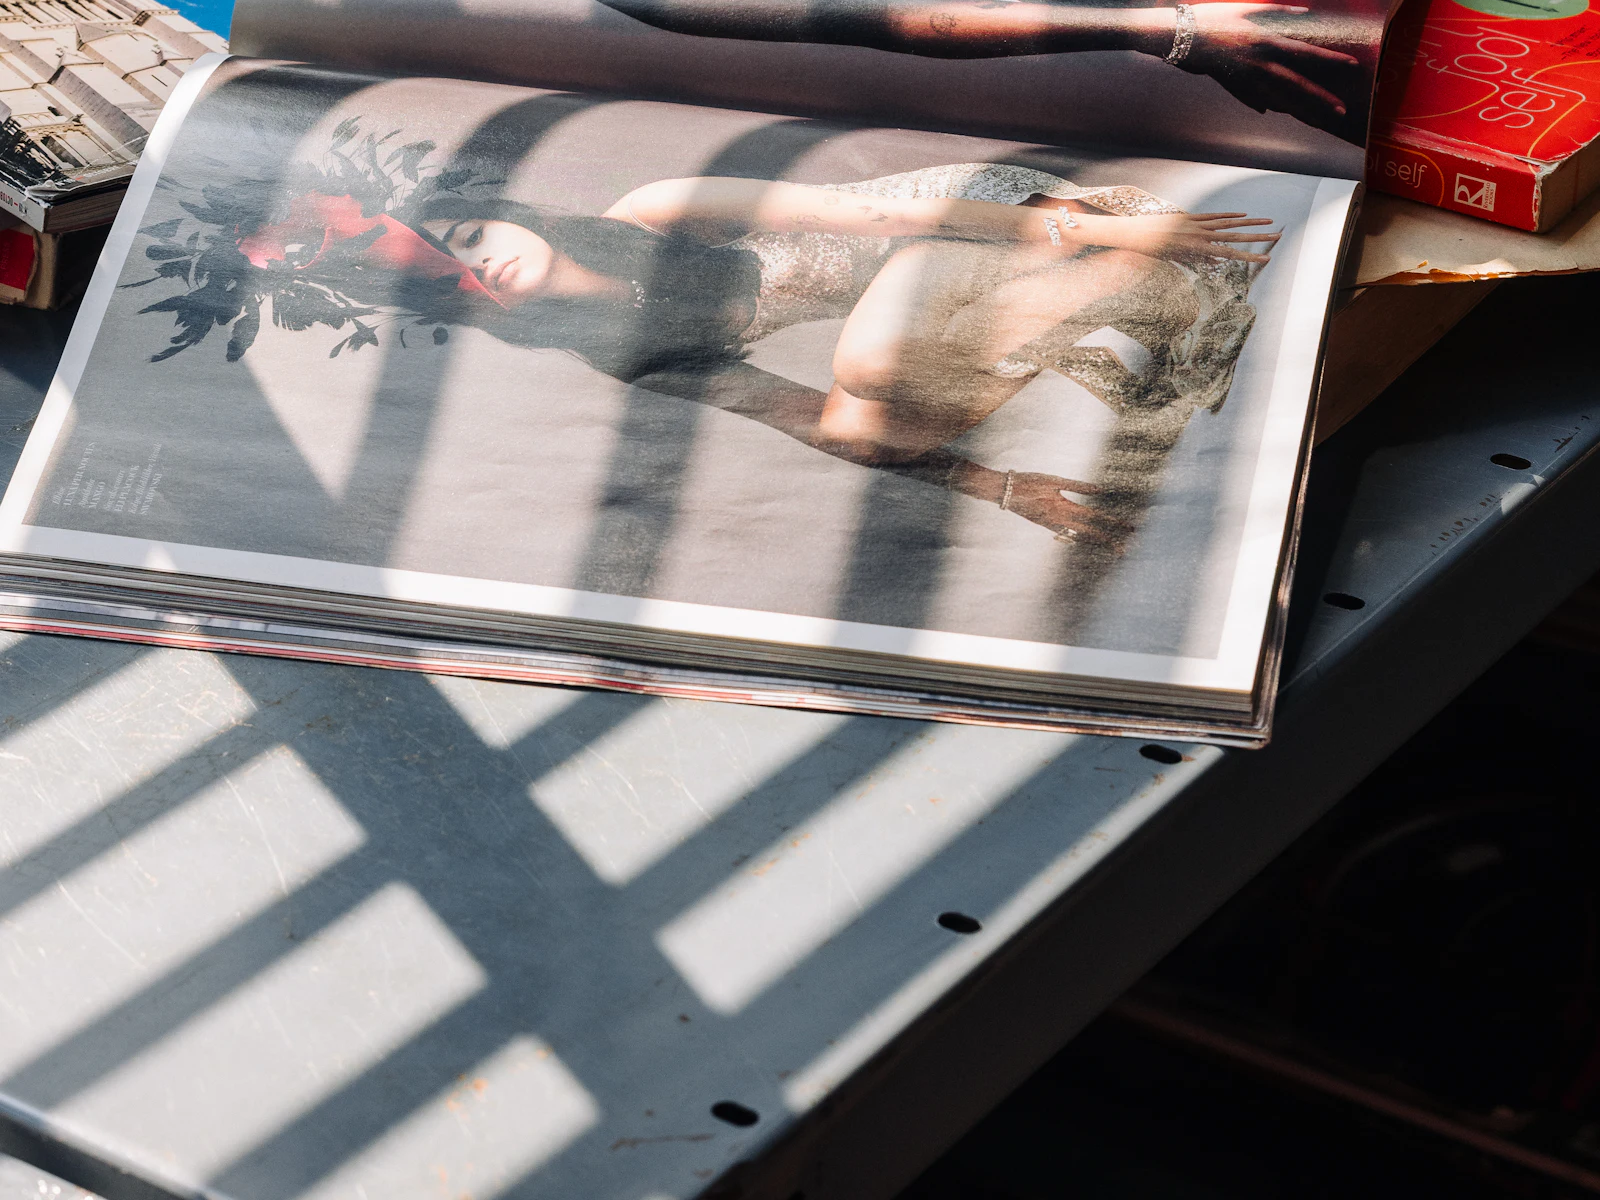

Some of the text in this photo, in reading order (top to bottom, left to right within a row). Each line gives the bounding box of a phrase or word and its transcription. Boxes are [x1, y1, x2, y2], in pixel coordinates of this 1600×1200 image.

[1478, 68, 1588, 130] self
[1385, 162, 1428, 189] self
[88, 481, 106, 509] MANGO
[140, 472, 164, 516] SWAROVSKI
